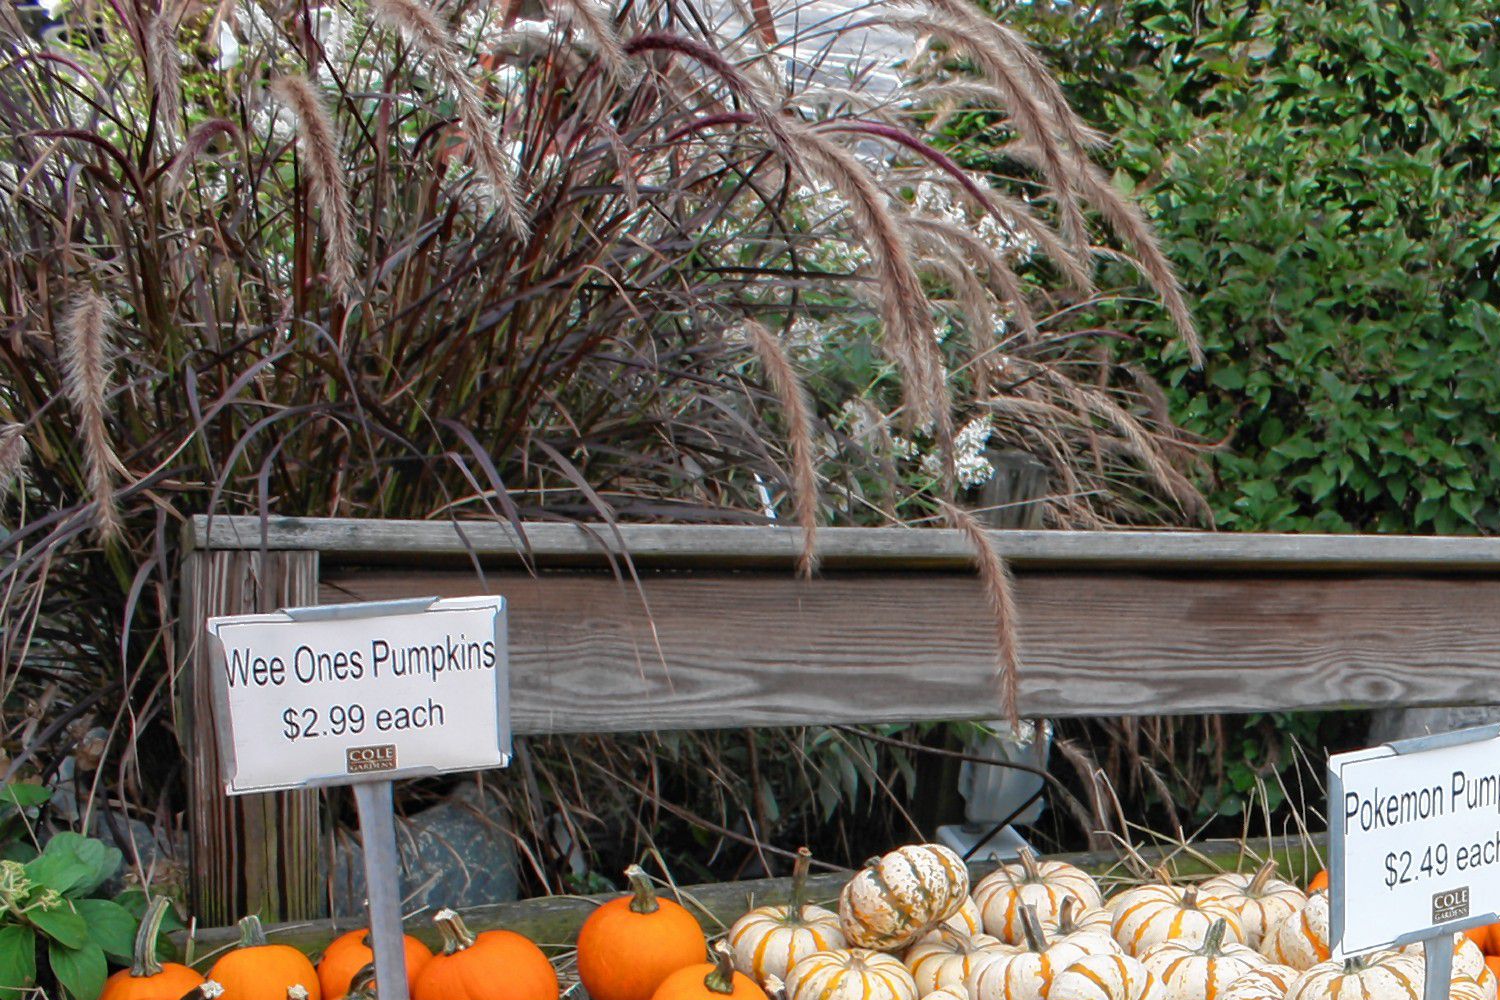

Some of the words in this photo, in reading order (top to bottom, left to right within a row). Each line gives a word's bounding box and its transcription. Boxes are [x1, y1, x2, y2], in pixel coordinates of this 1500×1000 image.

[226, 648, 286, 688] Wee
[294, 645, 364, 684] Ones
[372, 634, 496, 683] Pumpkins
[283, 703, 365, 742] $2.99
[376, 698, 445, 731] each
[350, 748, 393, 761] COLE
[1345, 785, 1443, 834] Pokemon
[1385, 843, 1448, 890] $2.49
[1434, 890, 1467, 909] COLE
